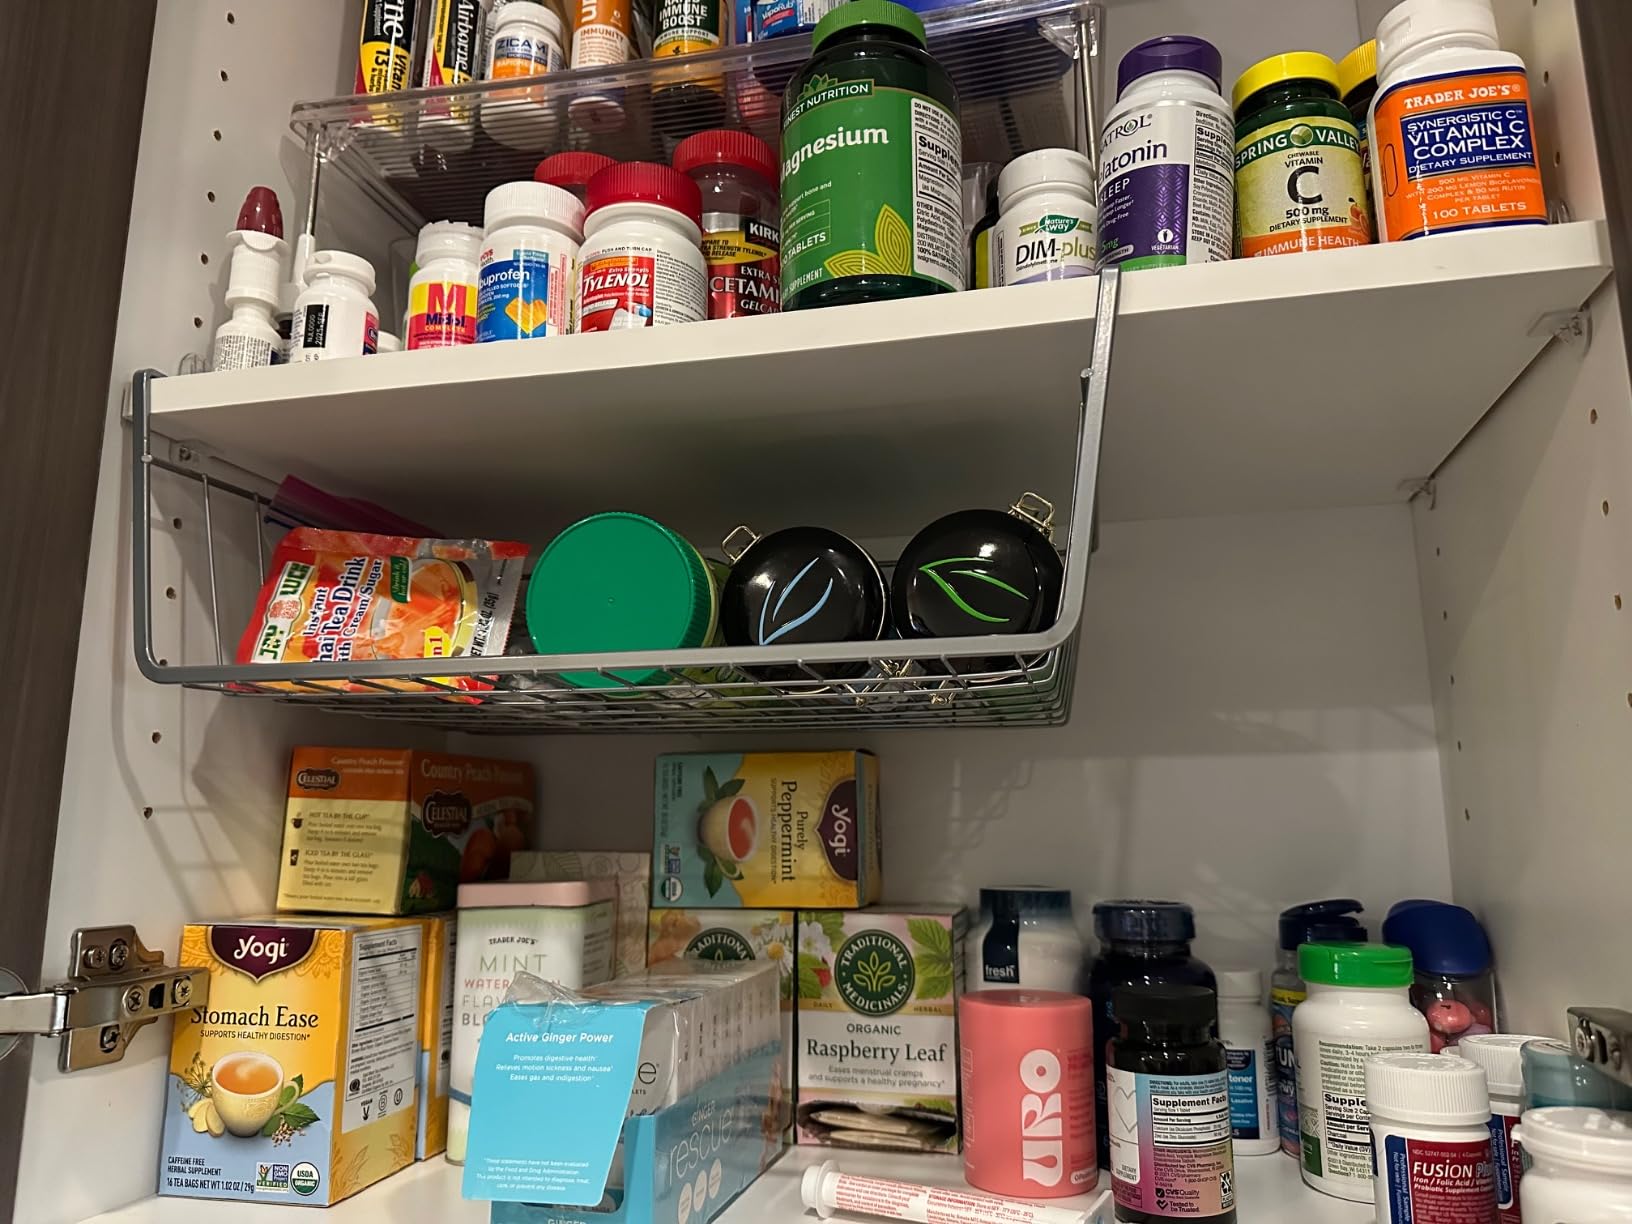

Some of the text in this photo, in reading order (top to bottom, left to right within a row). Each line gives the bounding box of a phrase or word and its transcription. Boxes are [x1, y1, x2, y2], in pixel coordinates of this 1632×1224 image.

[659, 4, 708, 22] IMMUNE
[761, 3, 794, 19] VapoRub
[663, 16, 700, 31] BOOST
[456, 0, 474, 71] Airborne
[580, 28, 625, 41] IMMUNITY
[496, 38, 547, 53] ZICAM
[374, 48, 391, 66] 13
[806, 83, 869, 109] NUTRITION
[1404, 84, 1511, 109] TRADER JOE'S
[1406, 110, 1503, 133] SYNERGISTIC
[1407, 120, 1526, 147] VITAMIN C
[1235, 128, 1360, 169] SPRING VALLEY
[1287, 150, 1320, 159] CHEWABLE
[1413, 134, 1525, 160] COMPLEX
[1284, 157, 1324, 168] VITAMIN
[1408, 151, 1533, 174] DIETARY SUPPLEMENT
[1287, 165, 1324, 205] C
[1439, 173, 1502, 185] 500 VITAMIN
[1426, 184, 1526, 201] COMPLEX RUTIN
[1427, 181, 1487, 194] 200 LEMON
[1455, 193, 1501, 204] PER TABLET
[1286, 206, 1330, 219] 500 mg
[1432, 201, 1527, 220] 100 TABLETS
[1044, 218, 1074, 226] Nature's
[1269, 215, 1348, 232] DIETARY SUPPLEMENT
[787, 230, 827, 261] TABLETS
[1015, 236, 1097, 266] DIM-plus
[1151, 243, 1180, 252] VEGETARIAN
[1263, 235, 1360, 256] IMMUNE HEALTH
[741, 265, 771, 281] EXTRA
[788, 267, 824, 295] SUPPLEMENT
[583, 273, 651, 297] TYLENOL
[428, 282, 468, 315] M
[425, 312, 466, 328] Midol
[424, 325, 466, 333] COMPLETE
[321, 558, 366, 634] Tea Drink
[342, 559, 383, 638] Cream/Sugar
[302, 588, 329, 636] Instant
[298, 772, 336, 785] CELESTIAL
[421, 758, 463, 784] Country
[769, 812, 777, 844] HEALTHY
[777, 780, 798, 883] Peppermint
[796, 810, 809, 851] Purely
[828, 804, 852, 856] yogi
[488, 936, 515, 945] TRADER
[233, 935, 288, 965] yogi
[840, 935, 909, 969] TRADITIONAL
[479, 954, 549, 973] MINT
[985, 964, 1015, 978] fresh
[842, 981, 910, 1012] MEDICINALS
[190, 1005, 319, 1029] Stomach Ease
[913, 1006, 944, 1014] HERBAL
[200, 1029, 236, 1040] SUPPORTS
[237, 1030, 268, 1041] HEALTHY
[846, 1023, 902, 1036] ORGANIC
[505, 1032, 614, 1044] Active Ginger Power
[513, 1054, 575, 1063] Promotes digestive
[806, 1038, 948, 1065] Raspberry Leaf
[521, 1064, 545, 1072] motion
[545, 1064, 572, 1072] sickness
[573, 1064, 587, 1072] and
[828, 1065, 924, 1080] Eases menstrual cramps
[509, 1073, 528, 1081] Eases
[529, 1074, 541, 1082] gas
[808, 1073, 823, 1081] and
[824, 1074, 859, 1086] supports
[866, 1076, 897, 1088] healthy
[1152, 1097, 1210, 1108] Supplement
[1325, 1103, 1342, 1113] Serving
[1342, 1106, 1354, 1114] Size
[691, 1100, 716, 1127] GINGER
[1018, 1048, 1064, 1188] URO
[1325, 1109, 1346, 1119] Servings
[1326, 1120, 1355, 1131] Amount per
[668, 1107, 733, 1186] rescue
[1497, 1128, 1507, 1166] Professional
[167, 1156, 205, 1166] CAFFEINE FREE
[167, 1165, 222, 1176] HERBAL SUPPLEMENT
[274, 1170, 288, 1178] GMO
[296, 1170, 314, 1178] USDA
[1115, 1168, 1138, 1182] SUPPLEMENT
[1121, 1164, 1137, 1175] DIETARY
[1399, 1152, 1409, 1194] Professional
[166, 1177, 174, 1187] 16
[173, 1178, 184, 1188] TEA
[184, 1179, 199, 1189] BAGS
[199, 1179, 211, 1190] NET
[211, 1180, 221, 1190] WT
[221, 1181, 232, 1191] 1.02
[232, 1181, 241, 1191] OZ
[244, 1182, 255, 1194] 29g
[256, 1179, 289, 1189] VERIFIED
[294, 1179, 316, 1187] ORGANIC
[1413, 1175, 1429, 1184] Iron
[1430, 1177, 1435, 1185] /
[1436, 1178, 1454, 1186] Folic
[1454, 1178, 1470, 1187] Acid
[1413, 1183, 1480, 1194] Probiotic Supplement
[1179, 1189, 1200, 1197] Quality
[1402, 1195, 1411, 1222] Sample
